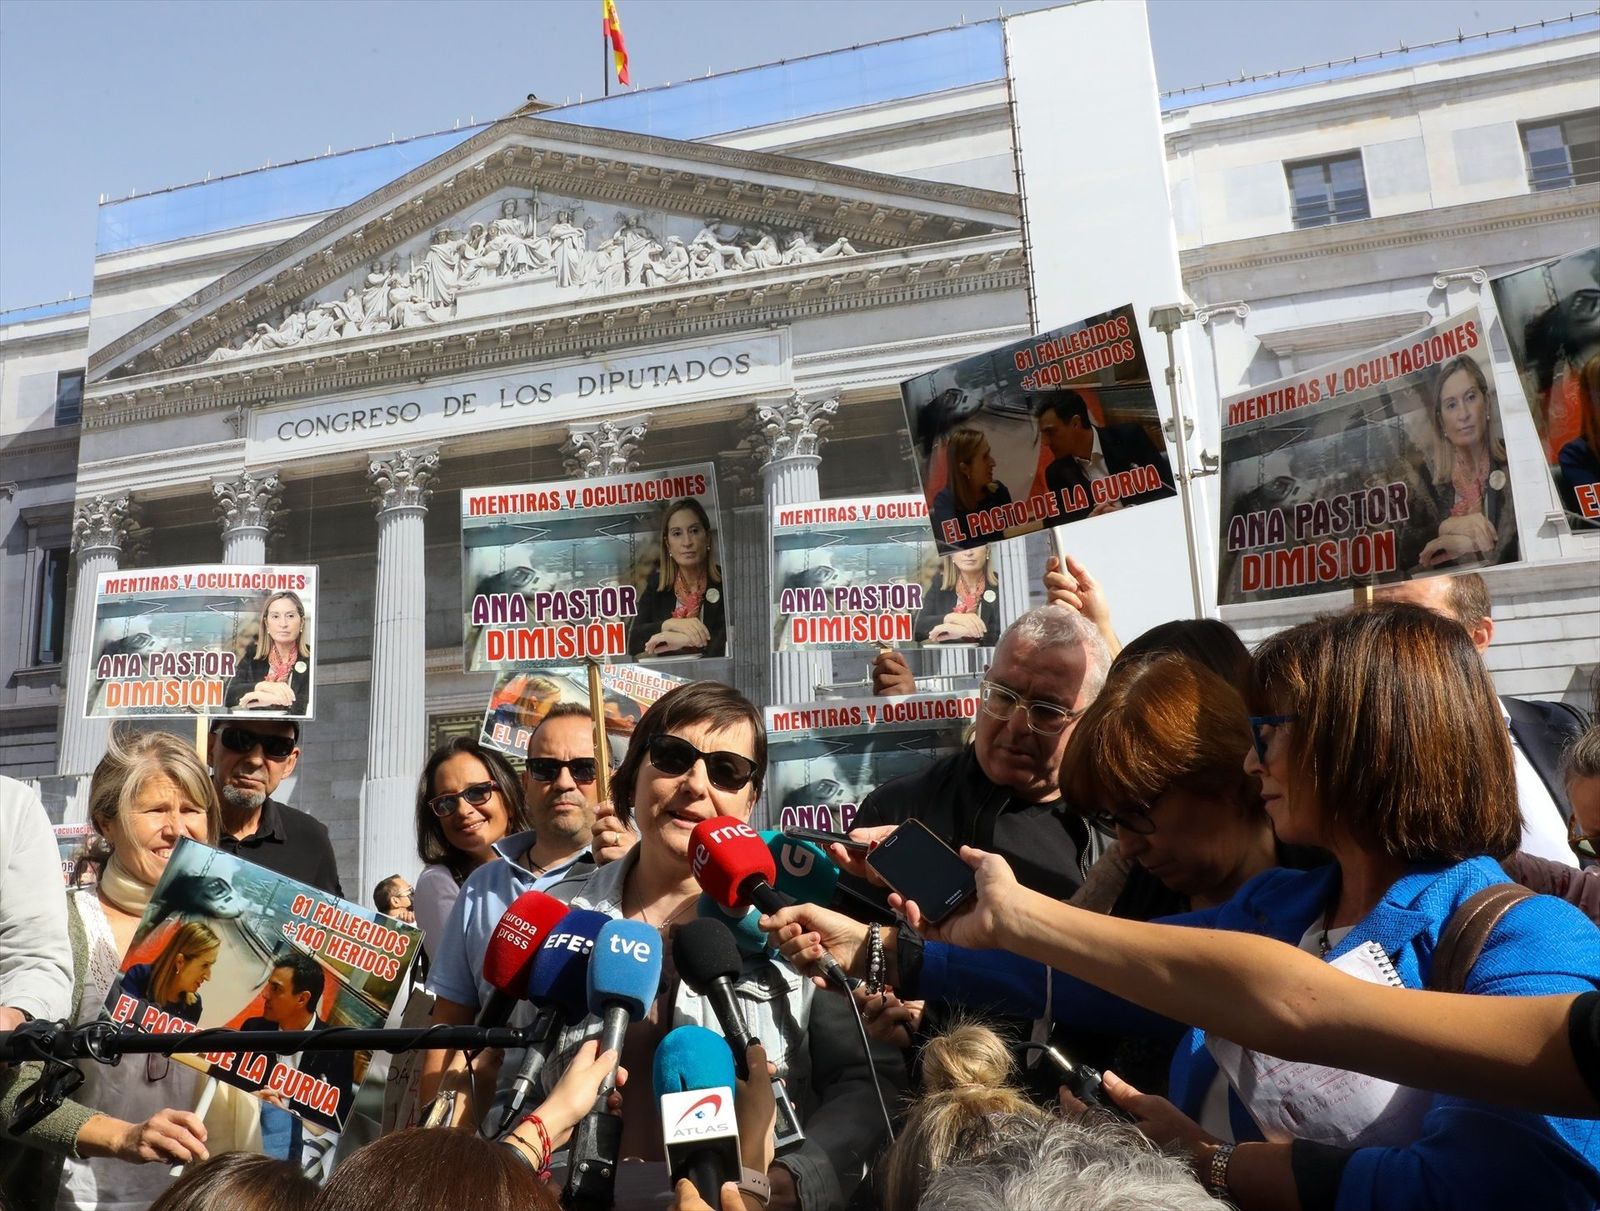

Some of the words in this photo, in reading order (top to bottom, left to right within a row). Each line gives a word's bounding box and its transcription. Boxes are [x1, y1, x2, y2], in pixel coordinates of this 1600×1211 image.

[1014, 347, 1034, 371] 81
[1036, 316, 1130, 364] FALLECIDOS
[1021, 365, 1063, 391] +140
[1064, 339, 1136, 380] HERIDOS
[1227, 378, 1321, 426] MENTIRAS
[1325, 374, 1339, 398] Y
[1343, 320, 1479, 392] OCULTACIONES
[278, 402, 422, 441] CONGRESO
[443, 393, 478, 417] DE
[500, 382, 554, 407] LOS
[577, 354, 752, 397] DIPUTADOS
[469, 492, 561, 516] MENTIRAS
[566, 489, 577, 509] Y
[582, 474, 706, 507] OCULTACIONES
[941, 517, 967, 545] EL
[966, 498, 1030, 538] PACTO
[1033, 491, 1061, 520] DE
[1061, 484, 1090, 512] LA
[1091, 464, 1163, 503] CURVA
[779, 506, 857, 526] MENTIRAS
[861, 504, 871, 520] Y
[1227, 508, 1286, 551] ANA
[1294, 481, 1410, 539] PASTOR
[1240, 526, 1397, 593] DIMISIÓN
[105, 573, 178, 594] MENTIRAS
[183, 573, 193, 590] Y
[196, 572, 306, 591] OCULTACIONES
[781, 588, 827, 614] ANA
[834, 583, 923, 611] PASTOR
[472, 593, 527, 625] ANA
[535, 585, 638, 622] PASTOR
[486, 619, 626, 662] DIMISIÓN
[791, 610, 913, 645] DIMISIÓN
[96, 654, 141, 679] ANA
[147, 650, 237, 678] PASTOR
[603, 663, 617, 676] 81
[104, 677, 224, 708] DIMISIÓN
[491, 722, 512, 746] EL
[773, 706, 861, 732] MENTIRAS
[866, 704, 877, 726] Y
[709, 824, 757, 844] rne
[780, 804, 833, 832] ANA
[291, 895, 310, 918] 81
[313, 902, 411, 958] FALLECIDOS
[497, 926, 530, 951] press
[502, 911, 538, 936] europa
[282, 920, 326, 952] +140
[326, 941, 402, 983] HERIDOS
[609, 934, 651, 963] tve
[236, 1052, 267, 1086] LA
[268, 1062, 341, 1118] CURVA
[673, 1123, 729, 1137] ATLAS
